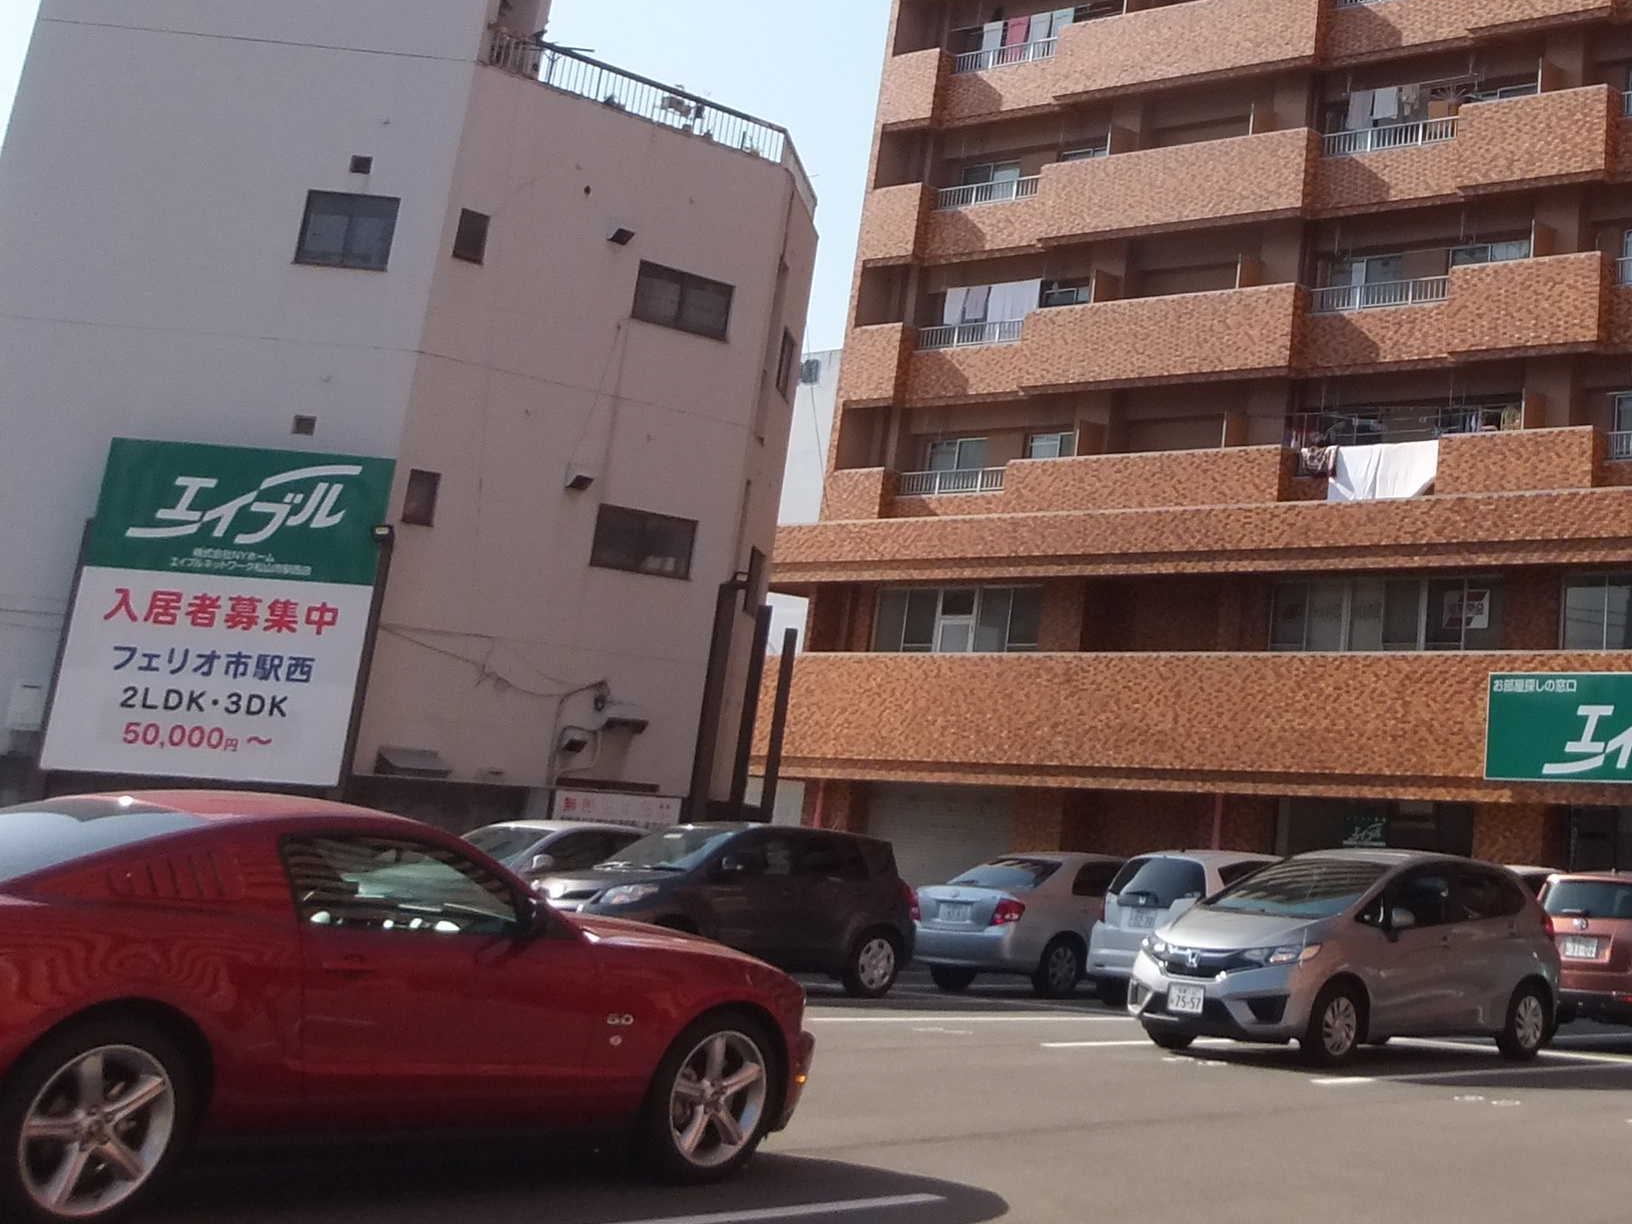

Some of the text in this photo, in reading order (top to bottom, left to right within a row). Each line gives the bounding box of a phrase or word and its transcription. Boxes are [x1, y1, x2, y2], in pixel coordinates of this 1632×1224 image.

[126, 464, 363, 544] エイブル
[103, 587, 340, 635] 入居者募集中
[112, 645, 316, 683] フェリオ市駅西
[1493, 679, 1577, 692] お部屋探しの窓口
